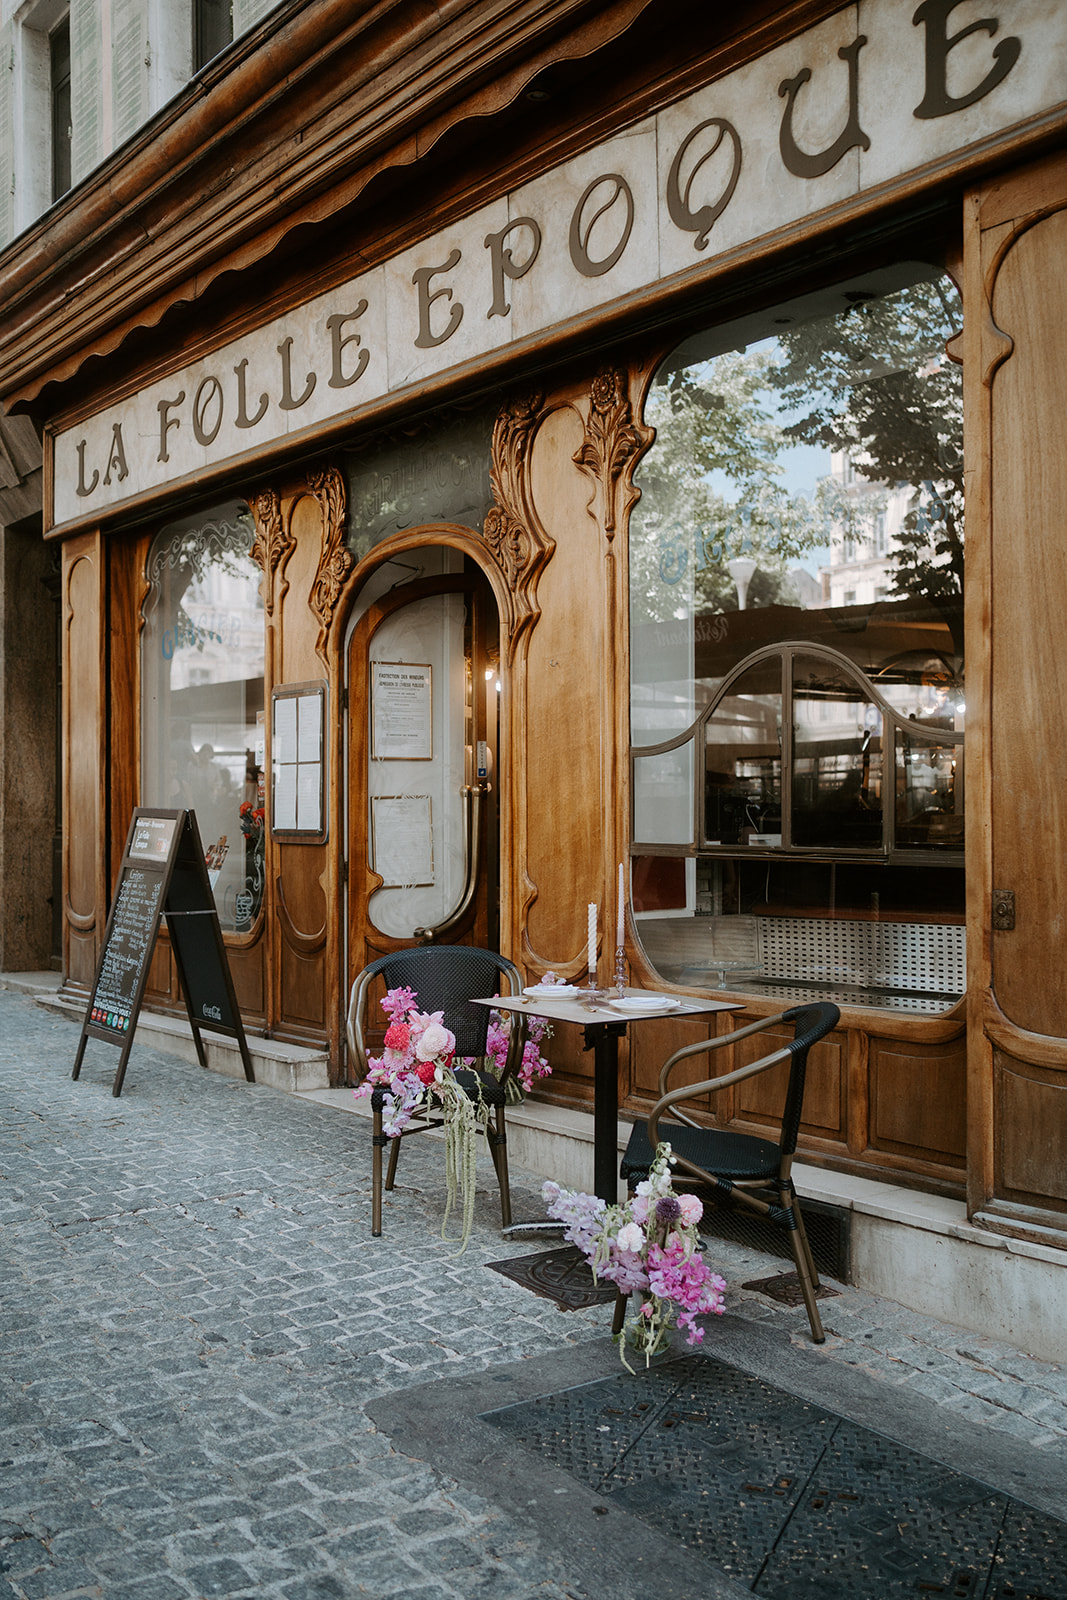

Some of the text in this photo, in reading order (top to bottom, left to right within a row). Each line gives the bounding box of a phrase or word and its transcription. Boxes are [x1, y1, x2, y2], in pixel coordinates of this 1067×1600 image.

[75, 0, 1022, 498] LA FOLLE EPOQUE
